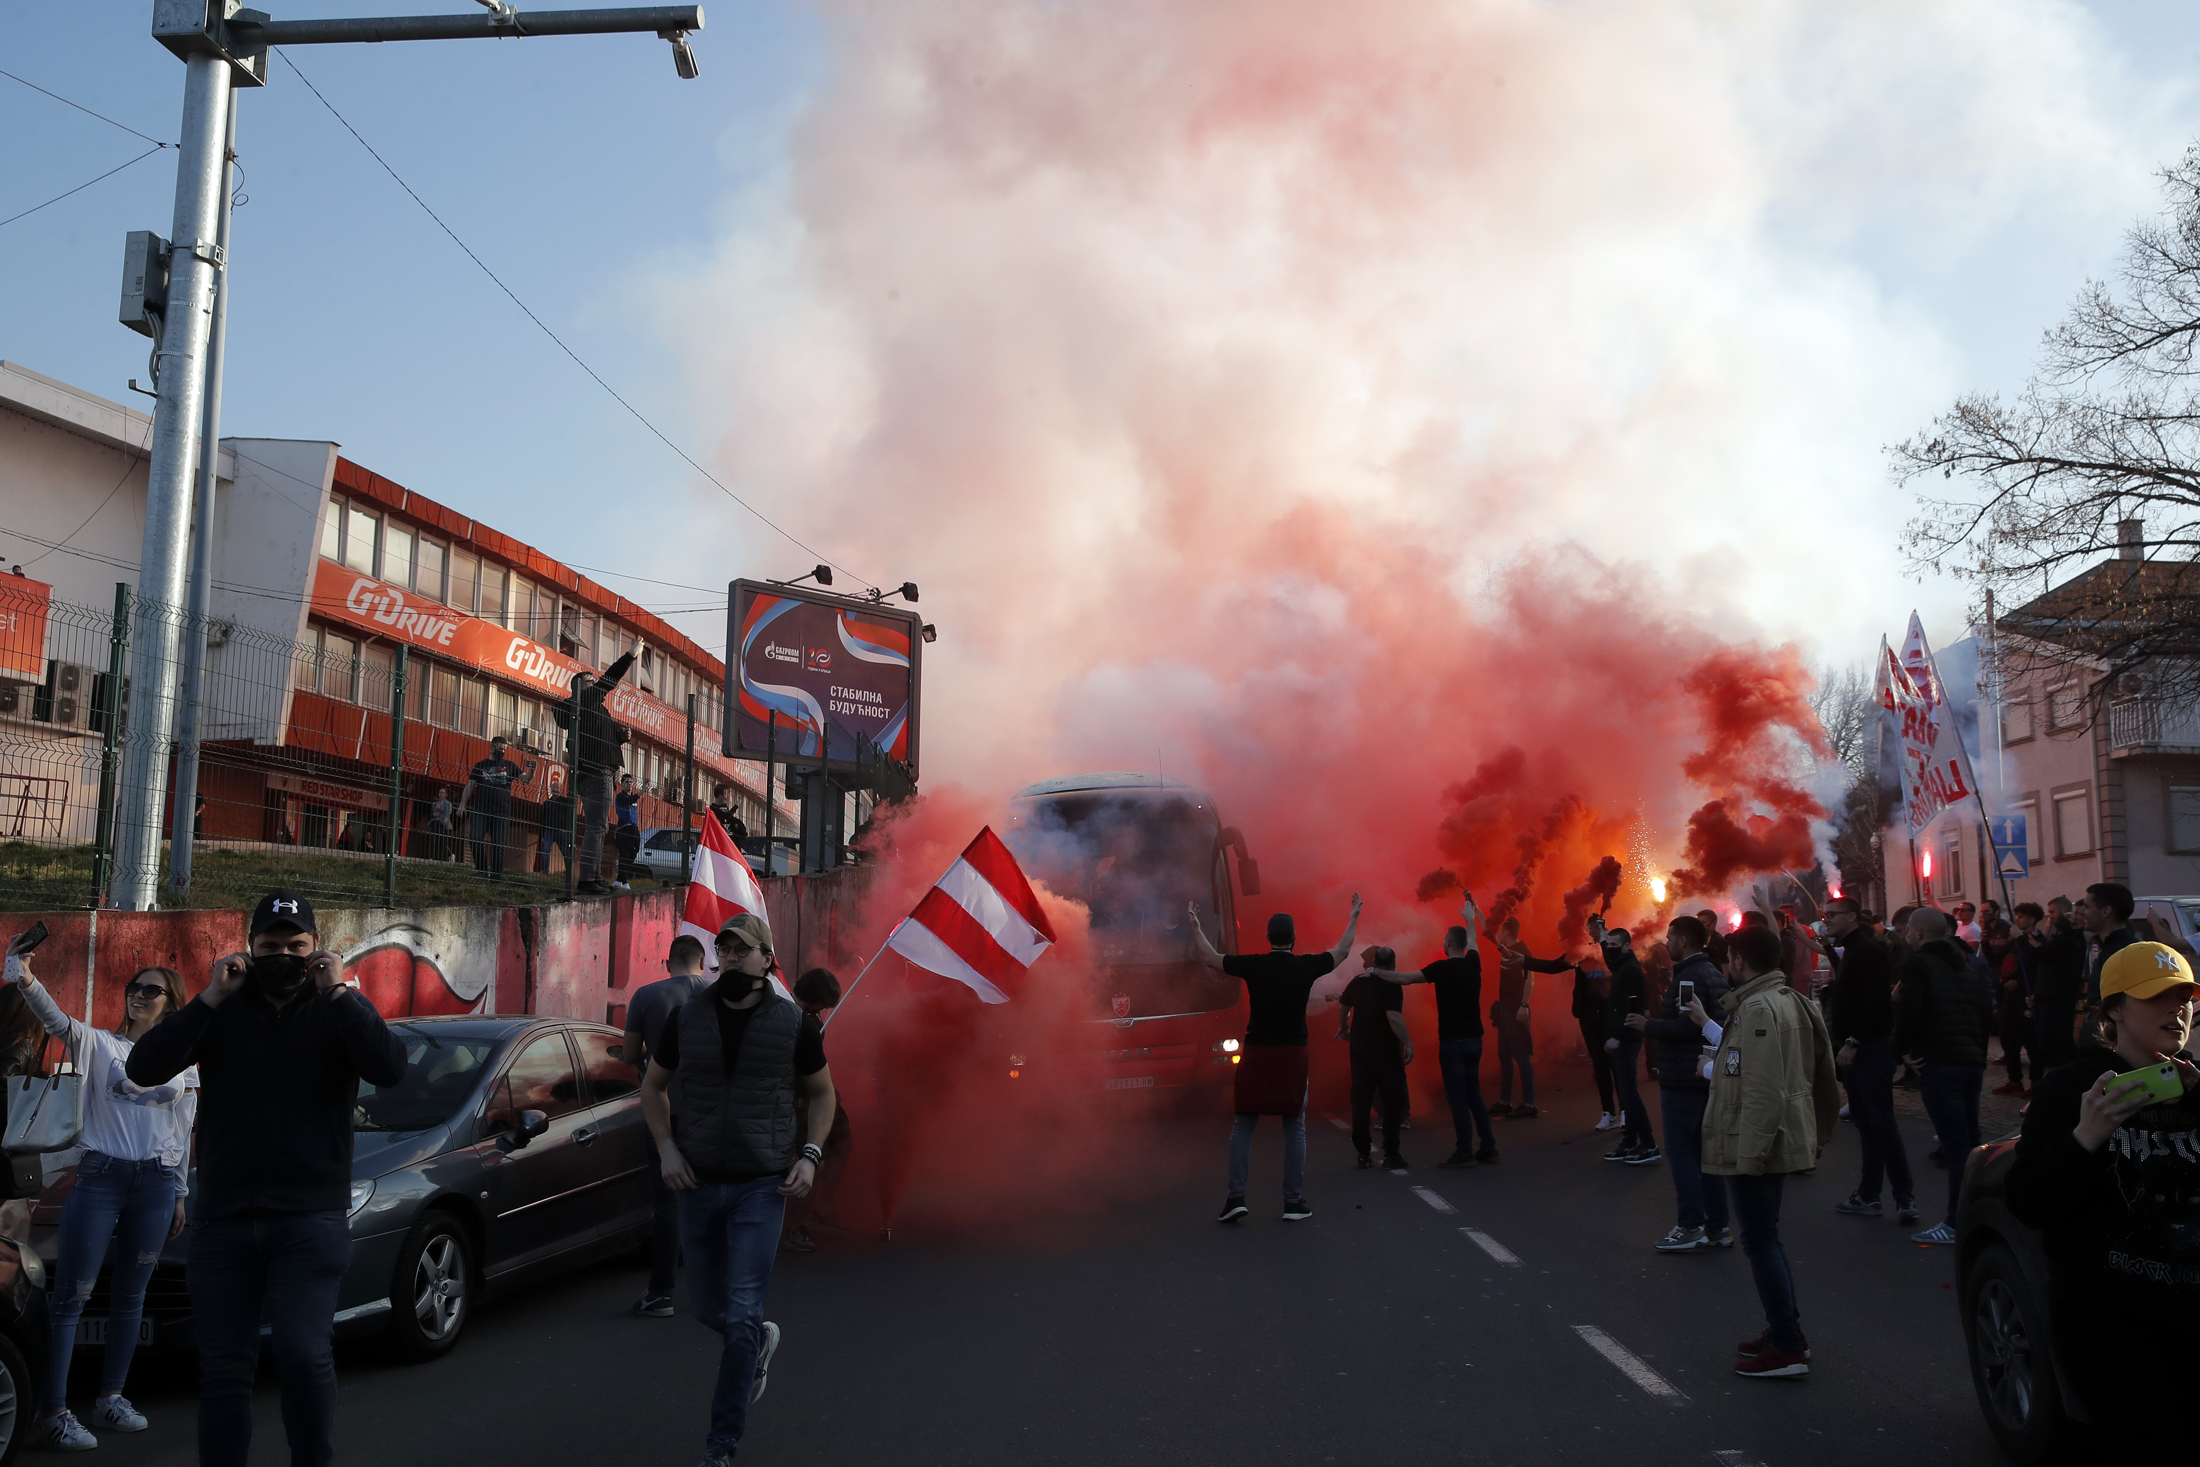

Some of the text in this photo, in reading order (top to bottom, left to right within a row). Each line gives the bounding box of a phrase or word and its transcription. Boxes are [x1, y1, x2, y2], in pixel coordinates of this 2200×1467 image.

[438, 608, 460, 622] FUEL
[830, 685, 882, 704] СТАБИЛНА
[829, 699, 890, 719] БУДУЋНОСТ
[301, 780, 363, 802] RED STAR SHOP
[2154, 950, 2181, 971] NY
[2108, 1250, 2174, 1286] BLACK
